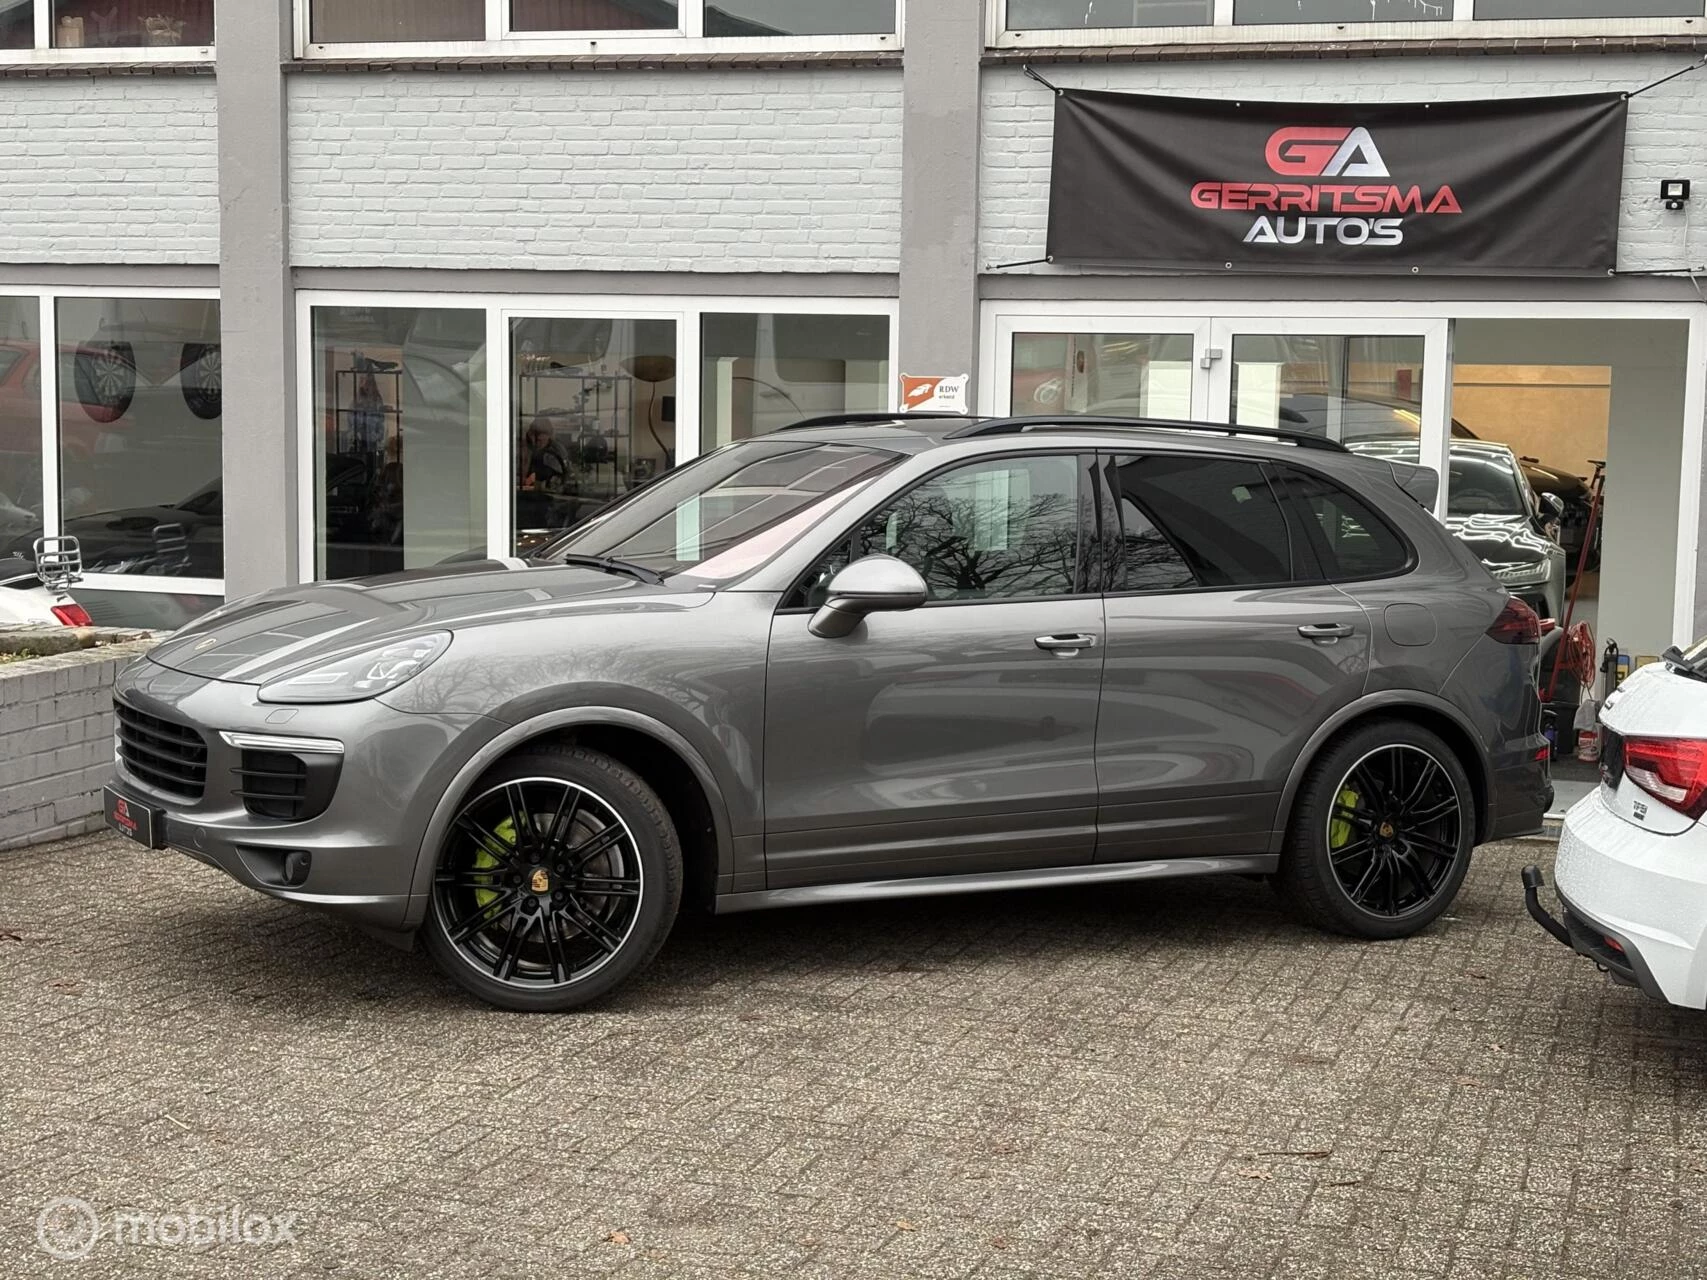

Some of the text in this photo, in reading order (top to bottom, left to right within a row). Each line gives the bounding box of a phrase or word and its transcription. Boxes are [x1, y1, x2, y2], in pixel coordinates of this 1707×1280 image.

[1264, 126, 1391, 177] GA
[1190, 181, 1463, 214] GERRITSMA
[1242, 215, 1404, 246] AUTO'S
[939, 385, 959, 393] RDW
